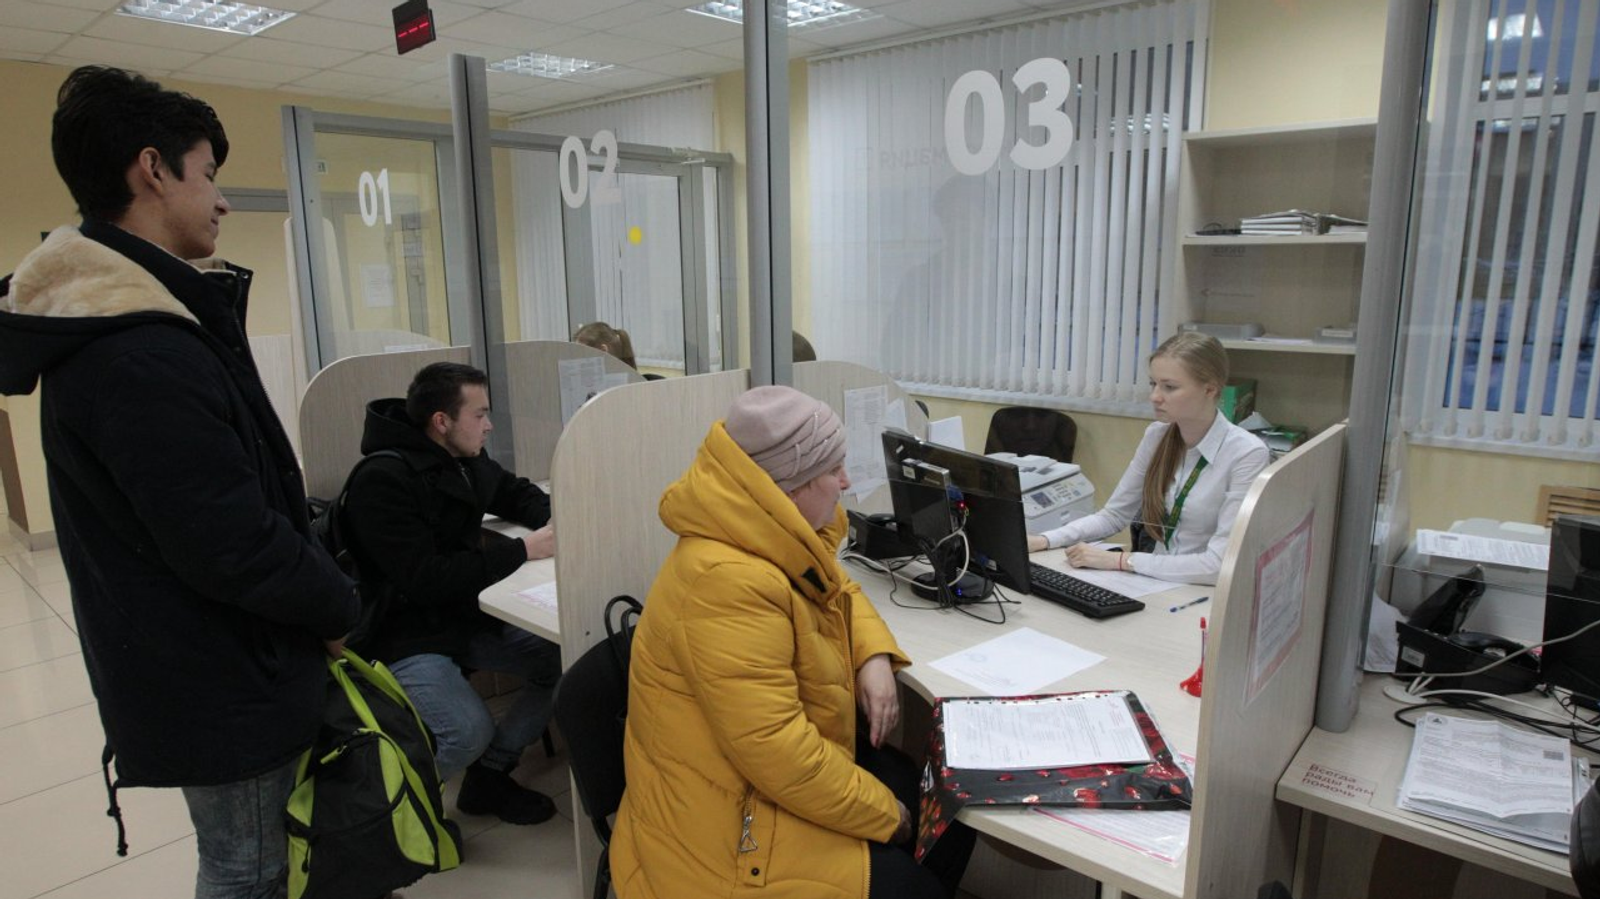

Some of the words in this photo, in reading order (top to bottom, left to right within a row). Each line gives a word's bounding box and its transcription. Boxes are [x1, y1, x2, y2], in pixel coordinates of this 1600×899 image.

[944, 57, 1073, 175] 03
[560, 130, 621, 208] 02
[359, 168, 392, 226] 01
[1302, 777, 1355, 798] помочь
[1305, 771, 1342, 786] рады
[1347, 783, 1374, 797] вам
[1309, 763, 1356, 783] Всегда
